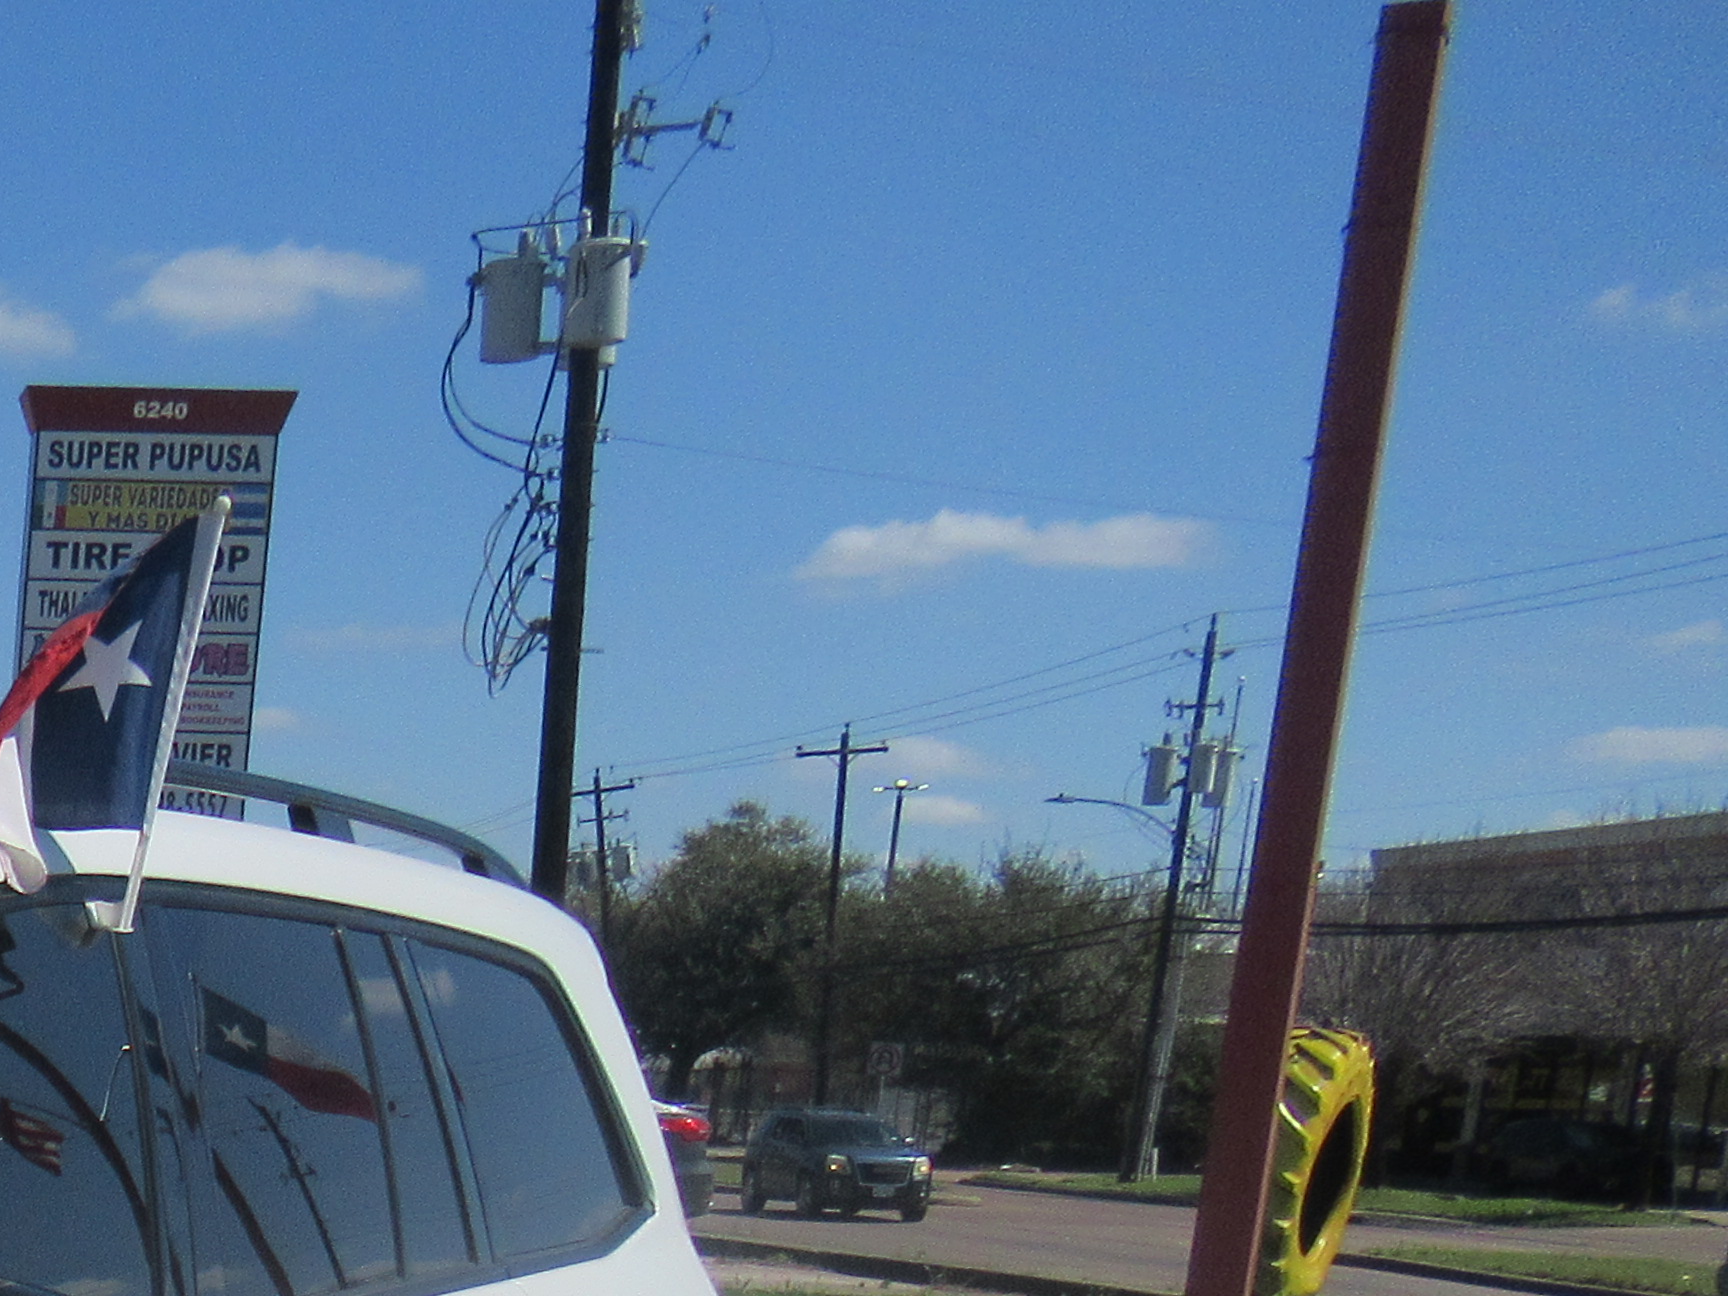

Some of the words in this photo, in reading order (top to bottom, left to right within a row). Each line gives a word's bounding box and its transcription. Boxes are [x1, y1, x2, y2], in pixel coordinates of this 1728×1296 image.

[133, 401, 188, 420] 6240
[47, 440, 139, 471] SUPER
[149, 441, 262, 473] PUPUSA
[69, 483, 123, 508] SUPER
[87, 511, 100, 529] Y
[106, 512, 148, 529] MAS
